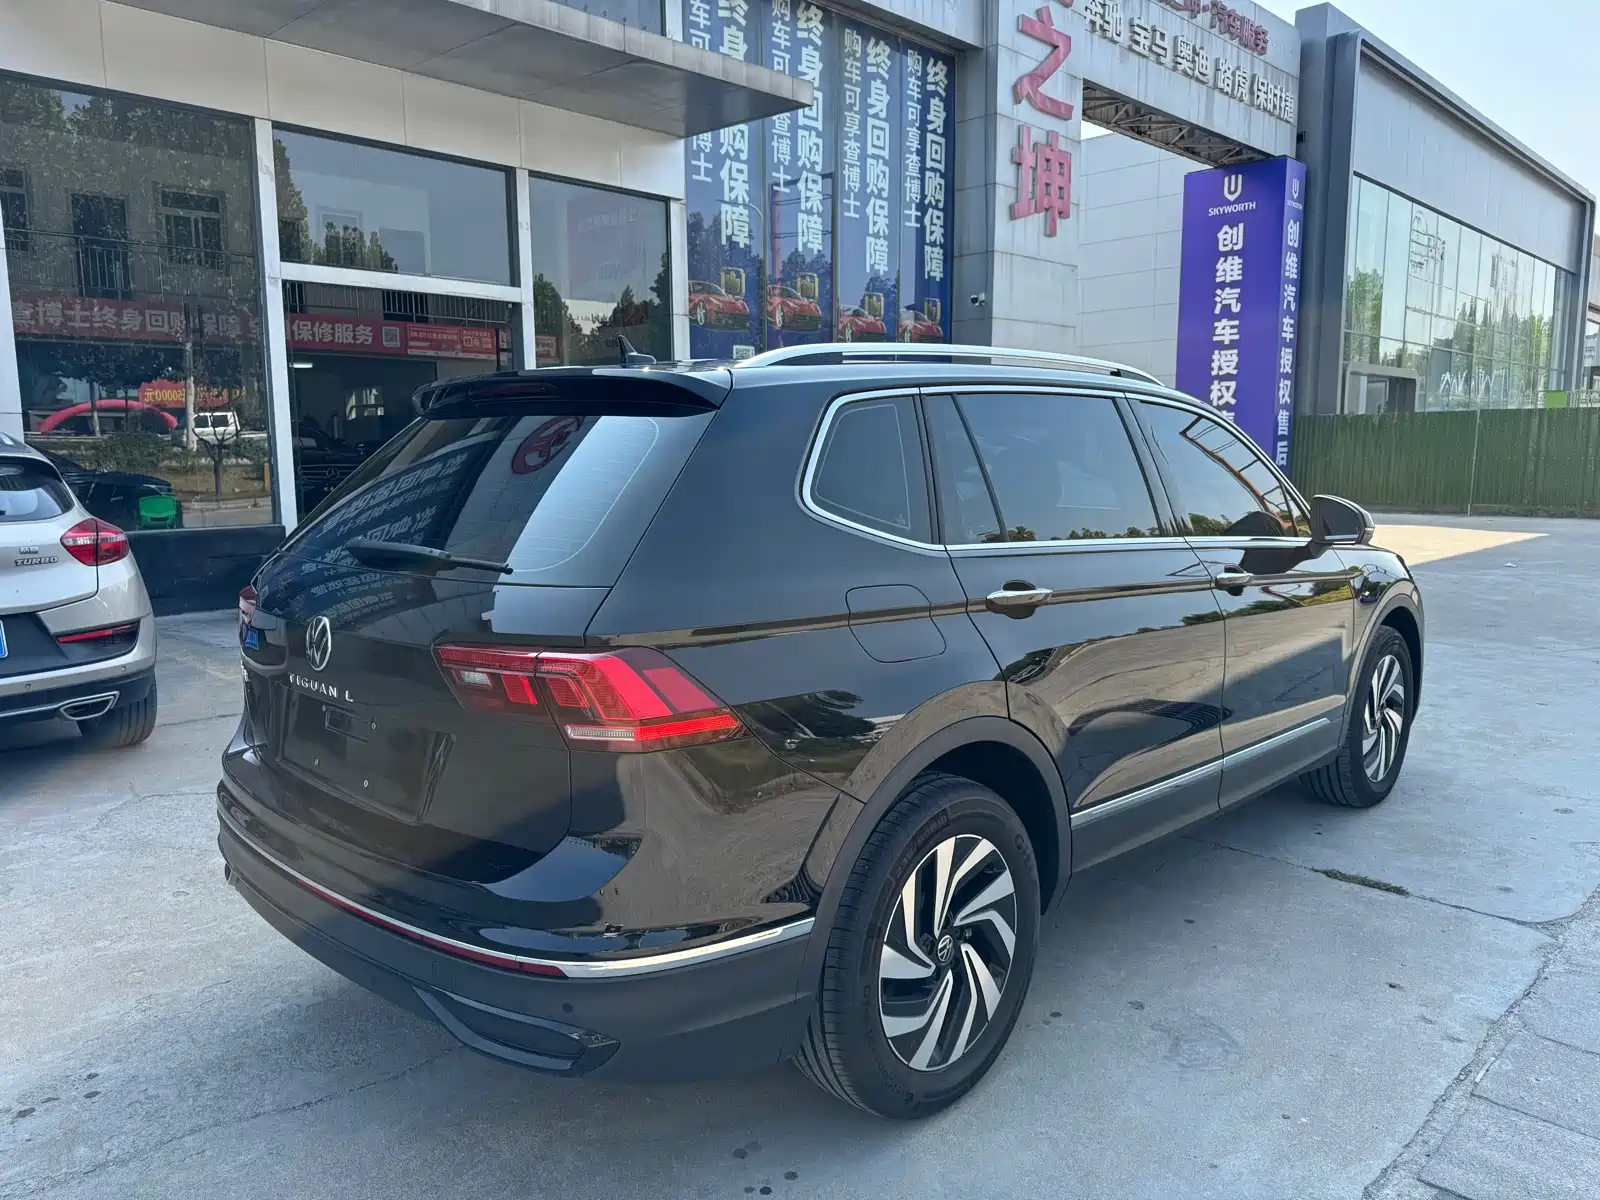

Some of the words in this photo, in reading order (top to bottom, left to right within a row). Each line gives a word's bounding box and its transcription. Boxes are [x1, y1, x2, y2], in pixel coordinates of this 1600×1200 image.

[717, 0, 751, 248] 终身购保障
[771, 0, 791, 194] 购车可查博士
[796, 5, 824, 254] 终身回购保障
[842, 28, 861, 219] 购车可享查博士
[865, 36, 891, 275] 终身回购保障
[904, 49, 923, 228] 购车可享查博士
[1084, 0, 1124, 44] 奔驰
[1130, 17, 1170, 66] 宝马
[1173, 35, 1210, 84] 奥迪
[1215, 56, 1249, 102] 路虎
[1252, 72, 1296, 123] 保时捷
[924, 57, 949, 282] 终身回购保障
[1208, 201, 1256, 217] SKYWORTH
[291, 318, 374, 346] 保修服务
[1209, 222, 1244, 424] 创维汽车授权
[1274, 219, 1300, 467] 创维汽车授权售后
[15, 556, 59, 567] TURBO
[289, 672, 338, 698] TIGUAN
[345, 690, 354, 702] L
